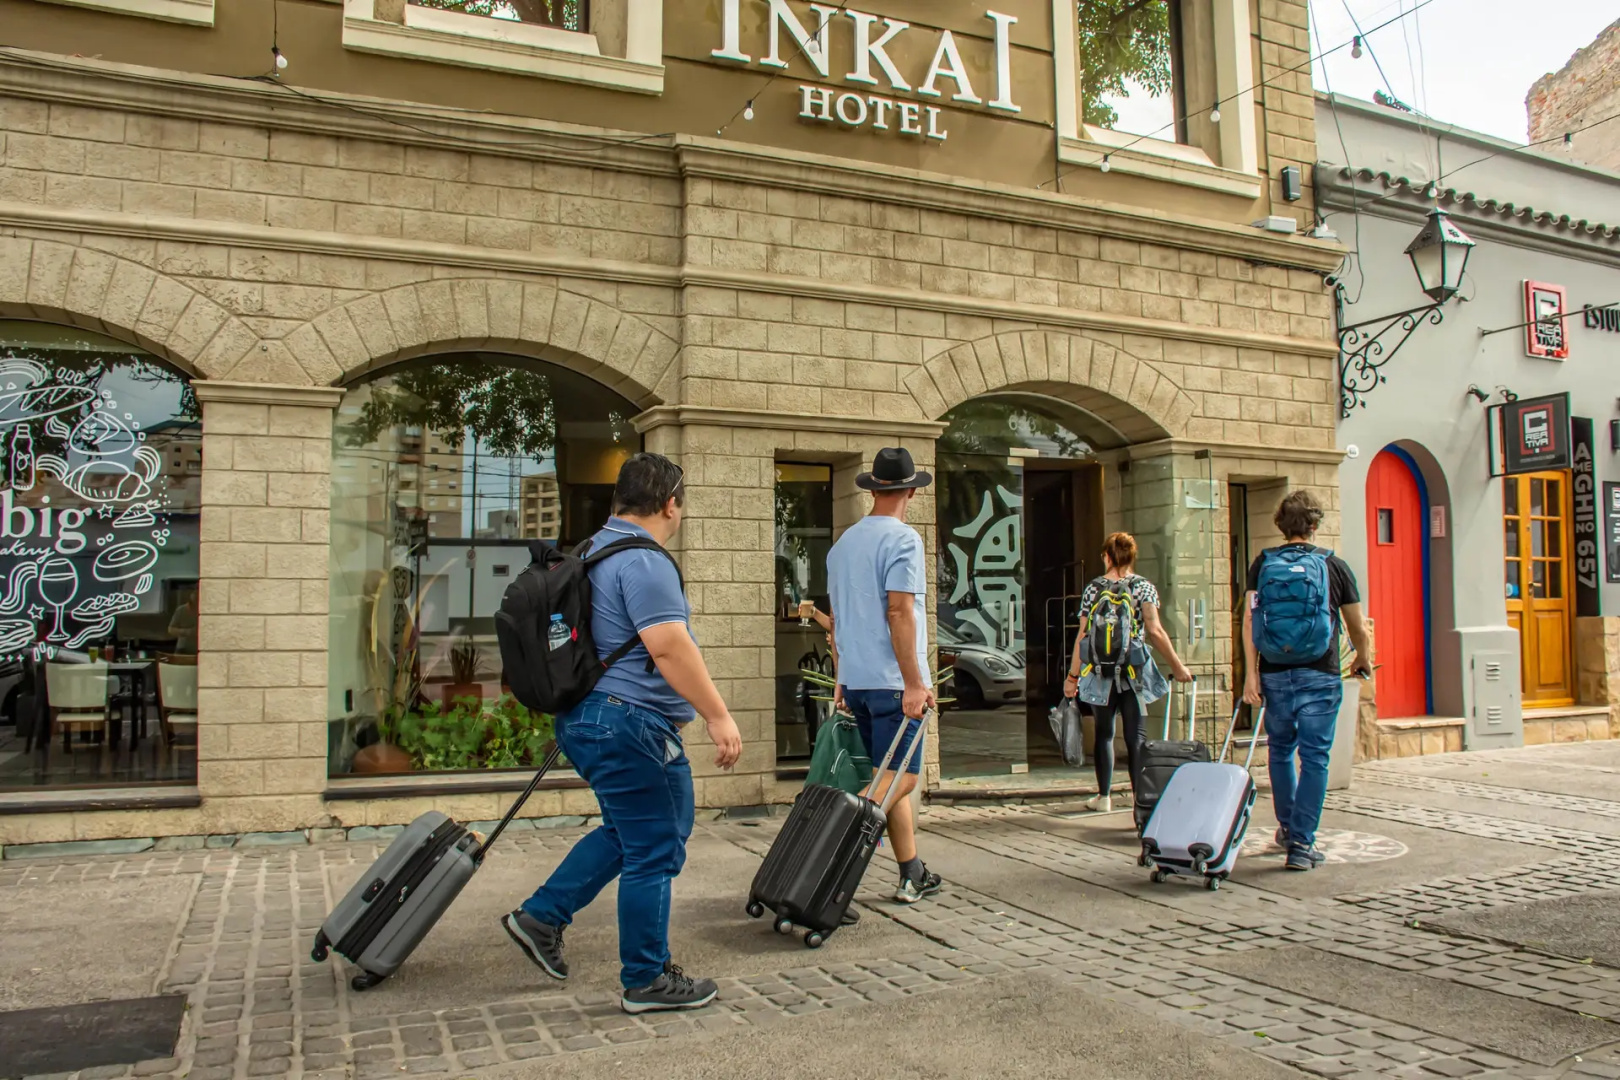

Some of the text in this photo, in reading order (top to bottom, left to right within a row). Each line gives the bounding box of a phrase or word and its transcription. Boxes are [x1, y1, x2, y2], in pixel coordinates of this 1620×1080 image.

[711, 0, 1021, 113] INKAI
[798, 85, 948, 140] HOTEL
[1584, 304, 1620, 332] ESTU
[0, 488, 93, 554] big
[1577, 539, 1597, 589] 657
